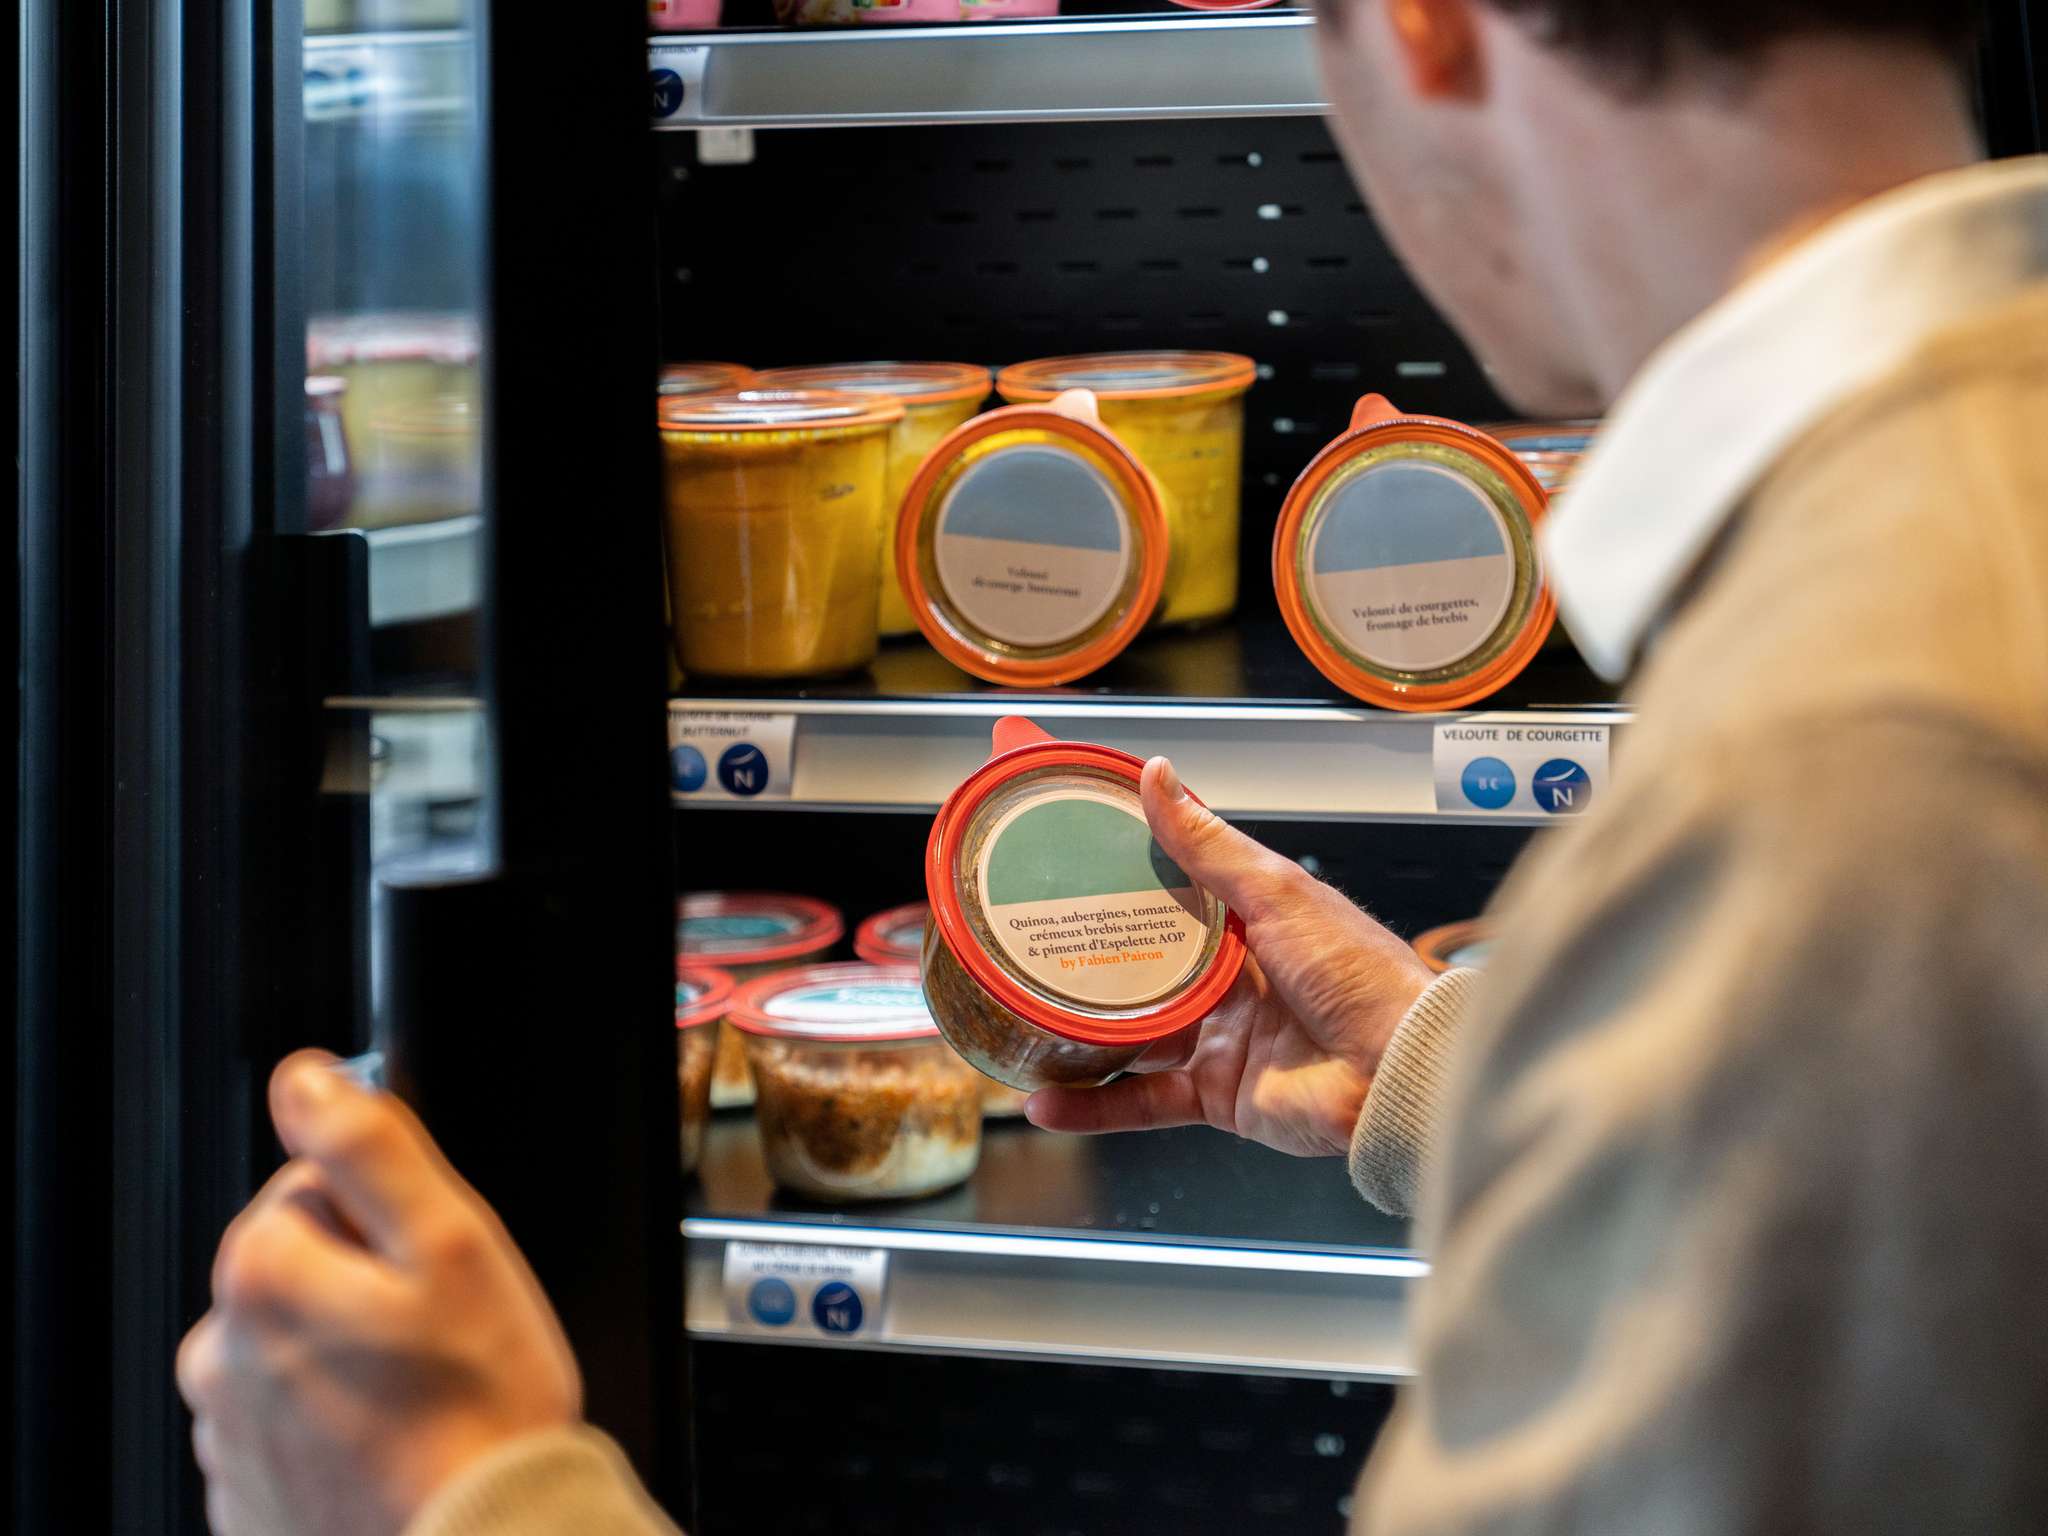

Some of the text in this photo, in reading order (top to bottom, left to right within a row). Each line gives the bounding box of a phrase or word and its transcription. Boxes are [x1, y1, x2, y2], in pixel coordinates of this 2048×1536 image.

[1352, 598, 1480, 619] Velouté de courgettes,
[1366, 611, 1468, 632] fromage de brebis
[1443, 729, 1603, 742] VELOUTE DE COURGETTE
[1552, 787, 1574, 807] N
[1009, 903, 1185, 930] Quinoa, aubergines, tomates,
[1029, 918, 1177, 942] crémeux brebis sarriette
[1028, 931, 1186, 958] & piment d'Espelette AOP
[1060, 949, 1164, 971] by Fabien Pairon
